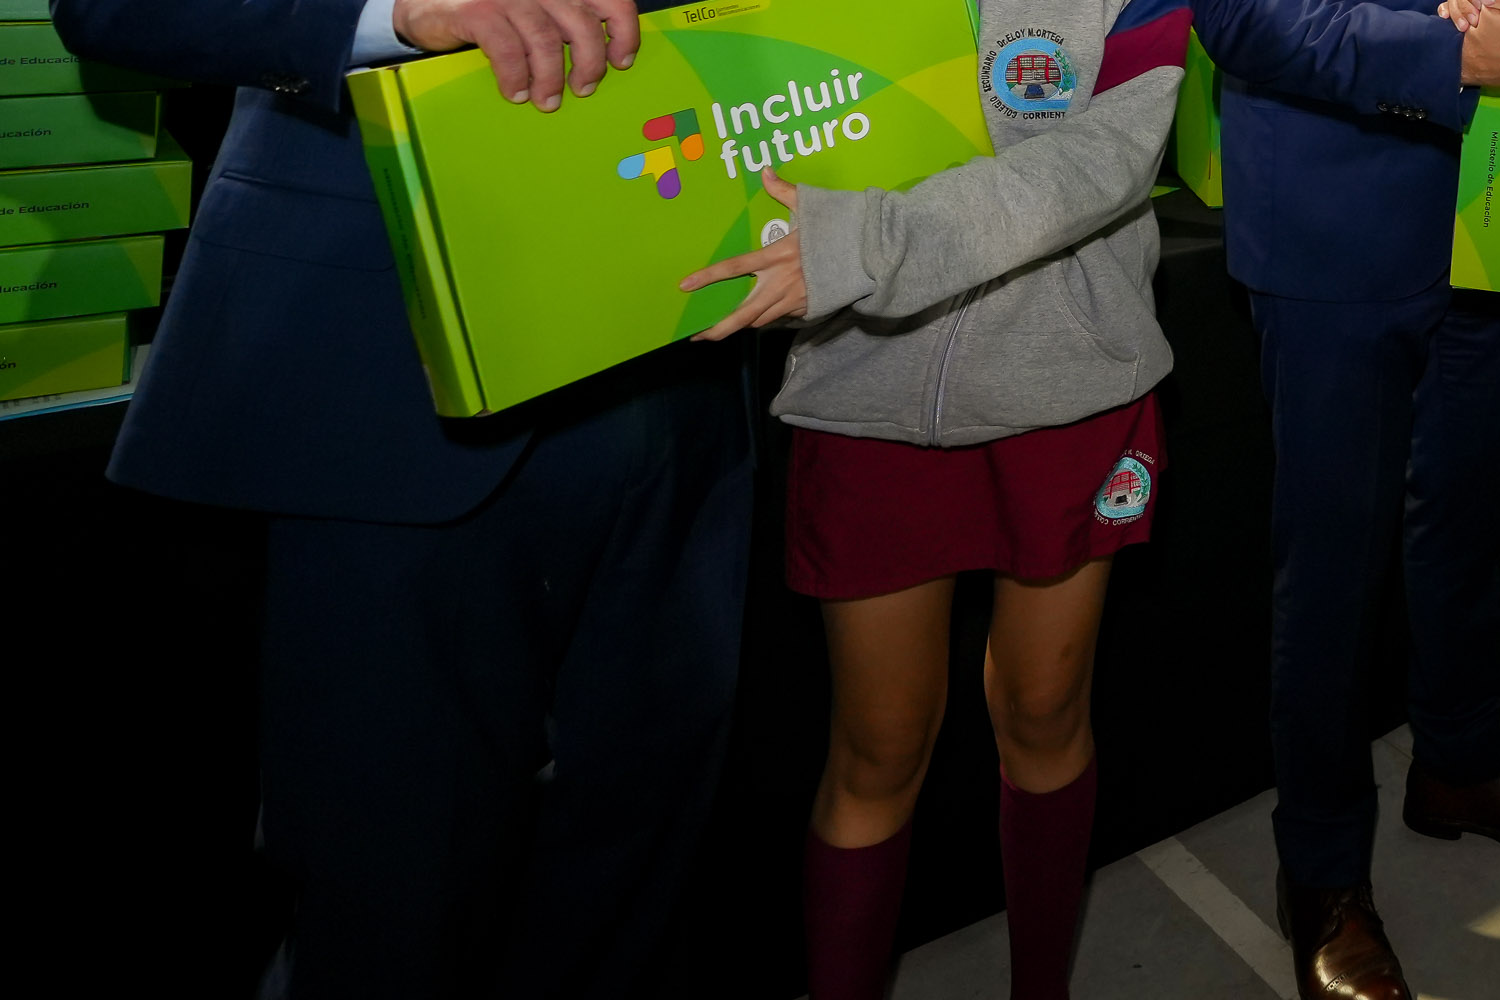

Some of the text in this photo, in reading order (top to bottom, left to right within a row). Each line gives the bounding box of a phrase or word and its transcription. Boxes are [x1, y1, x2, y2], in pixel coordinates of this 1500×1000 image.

[682, 6, 716, 24] TelCo
[980, 50, 997, 93] SECUNDARIO
[711, 68, 863, 139] Incluir
[989, 95, 1018, 119] COLEGIO
[720, 112, 870, 179] futuro
[1483, 131, 1499, 228] Ministerio de Educación
[19, 201, 90, 214] Educación
